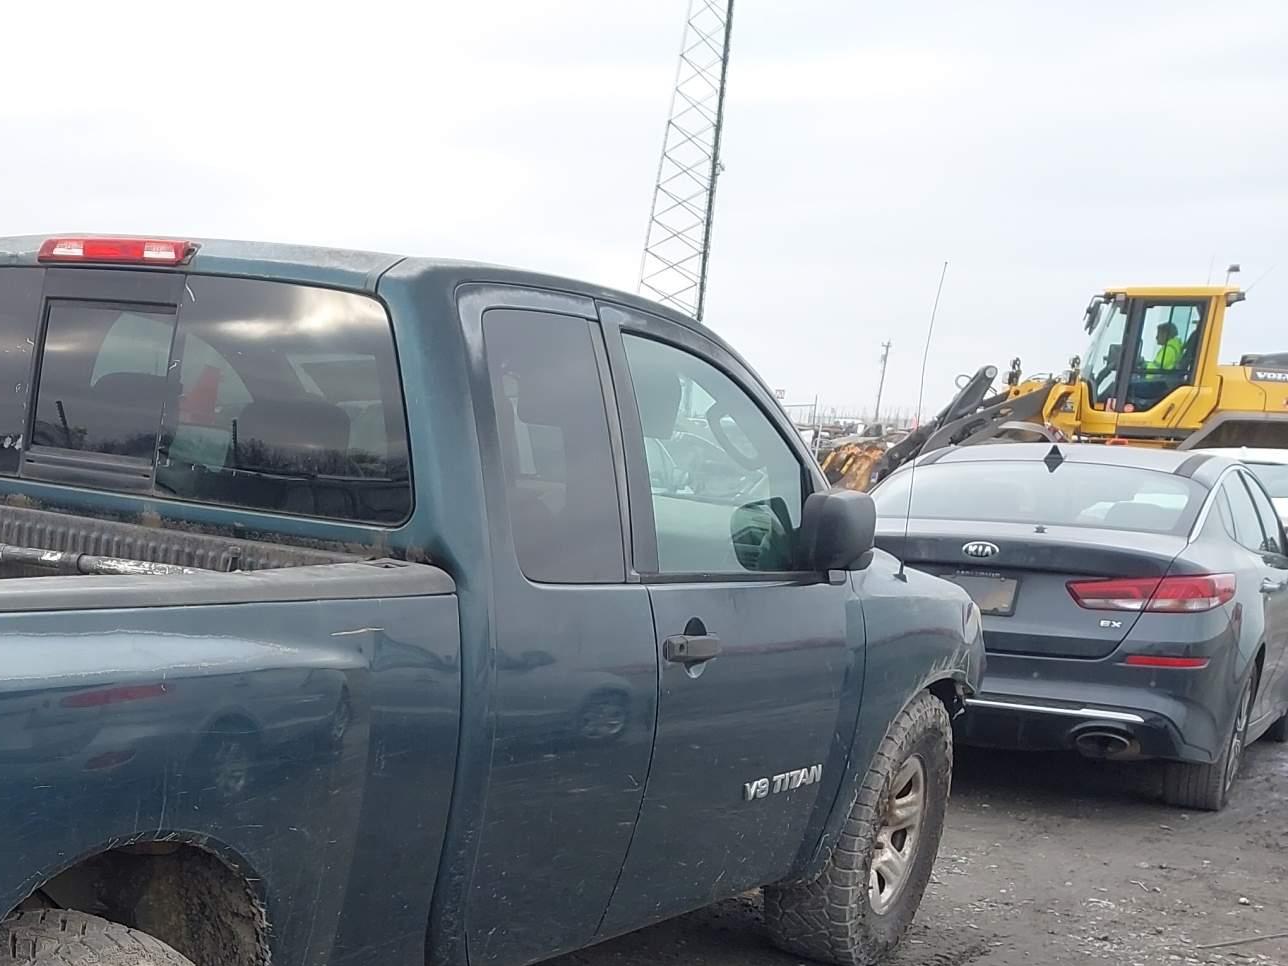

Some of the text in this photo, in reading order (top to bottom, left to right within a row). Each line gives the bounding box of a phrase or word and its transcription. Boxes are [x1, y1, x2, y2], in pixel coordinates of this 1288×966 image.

[967, 544, 993, 557] KIA
[1099, 619, 1123, 628] EX
[772, 763, 823, 794] TITAN
